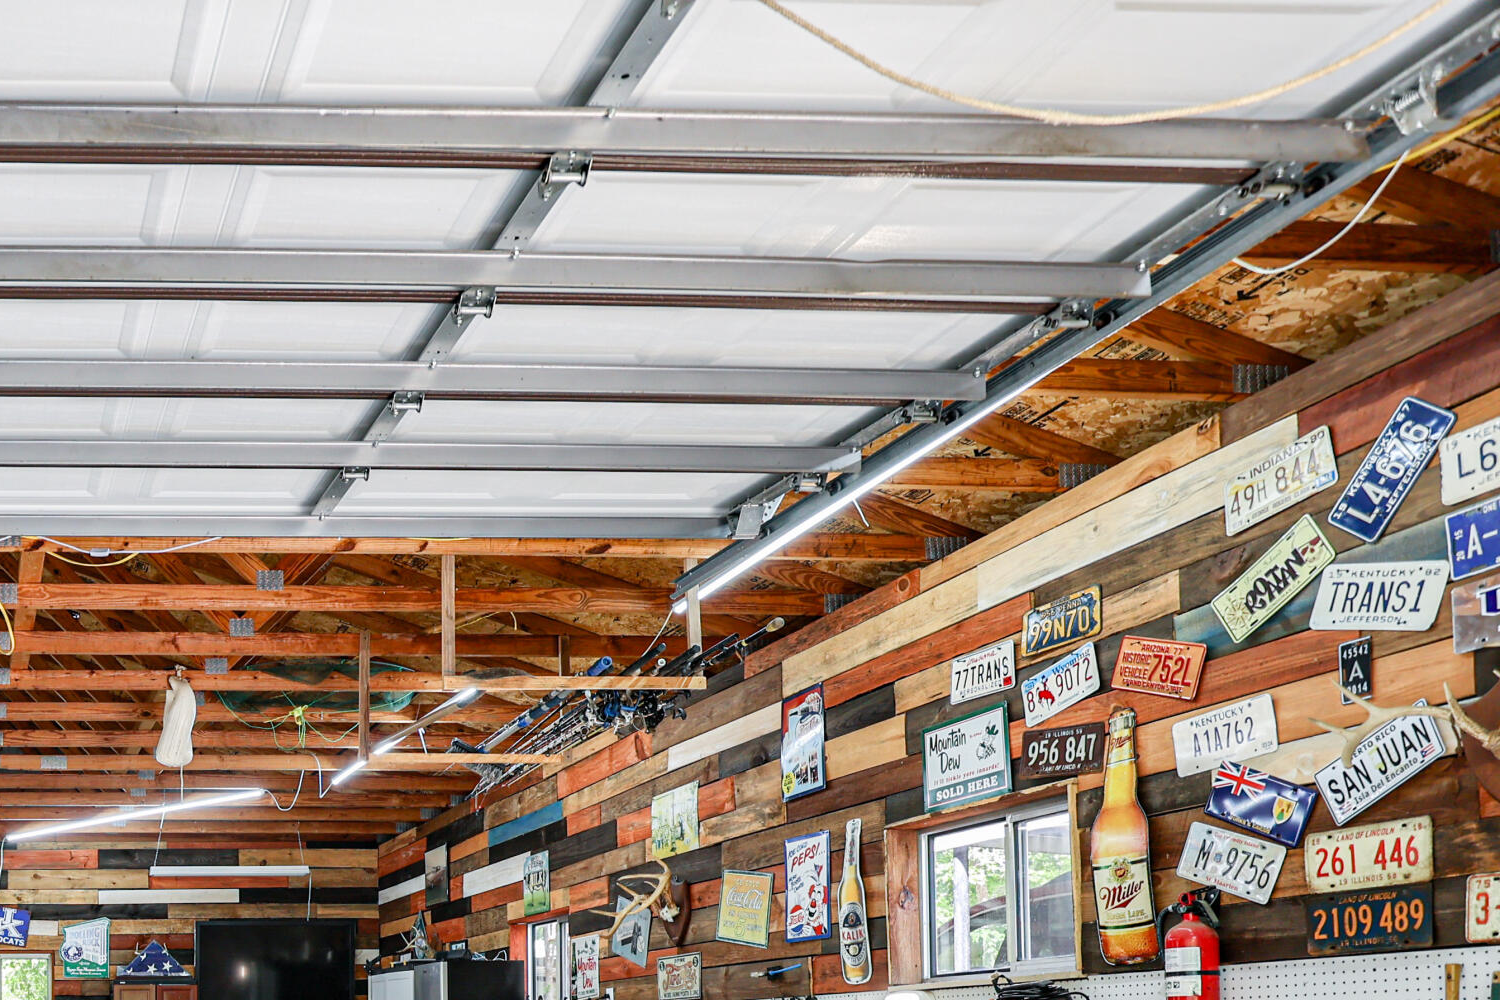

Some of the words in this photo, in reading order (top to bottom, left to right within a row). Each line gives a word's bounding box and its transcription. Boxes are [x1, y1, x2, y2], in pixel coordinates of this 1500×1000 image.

[1249, 444, 1302, 479] INDIANA
[1347, 429, 1395, 497] KENTUCKY
[1231, 479, 1268, 516] 49H
[1275, 448, 1319, 494] 844
[1351, 569, 1416, 578] KENTUCKY
[1329, 579, 1426, 613] TRANS1
[1030, 605, 1090, 650] 99N70
[1339, 615, 1402, 624] JEFFERSON
[1051, 648, 1091, 676] Wyoming
[1122, 651, 1153, 665] HISTORIC
[1141, 643, 1170, 654] ARIZONA
[954, 656, 1010, 691] 77TRANS
[1055, 657, 1093, 698] 9072
[1119, 664, 1149, 680] VEHICLE
[1148, 654, 1192, 687] 752L
[1349, 660, 1364, 682] A
[1194, 705, 1244, 728] KENTUCKY
[929, 728, 967, 756] Mountain
[1193, 716, 1257, 758] A1A762
[1375, 724, 1397, 740] RICO
[938, 752, 961, 774] Dew
[1028, 738, 1060, 767] 956
[1065, 732, 1097, 763] 847
[1328, 758, 1373, 806] SAN
[1376, 717, 1431, 775] JUAN
[936, 786, 964, 801] SOLD
[967, 775, 999, 793] HERE
[1354, 790, 1370, 805] Isla
[1371, 780, 1385, 793] Del
[1386, 756, 1418, 783] Encanto
[1336, 832, 1354, 842] LAND
[1354, 831, 1364, 840] OF
[1364, 827, 1396, 839] LINCOLN
[1195, 838, 1214, 870] M
[1222, 847, 1275, 889] 9756
[1315, 843, 1357, 878] 261
[1374, 834, 1419, 871] 446
[1351, 874, 1384, 885] ILLINOIS
[1099, 880, 1145, 910] Miller
[1313, 904, 1373, 940] 2109
[1379, 898, 1424, 934] 489
[841, 929, 865, 941] KALIK
